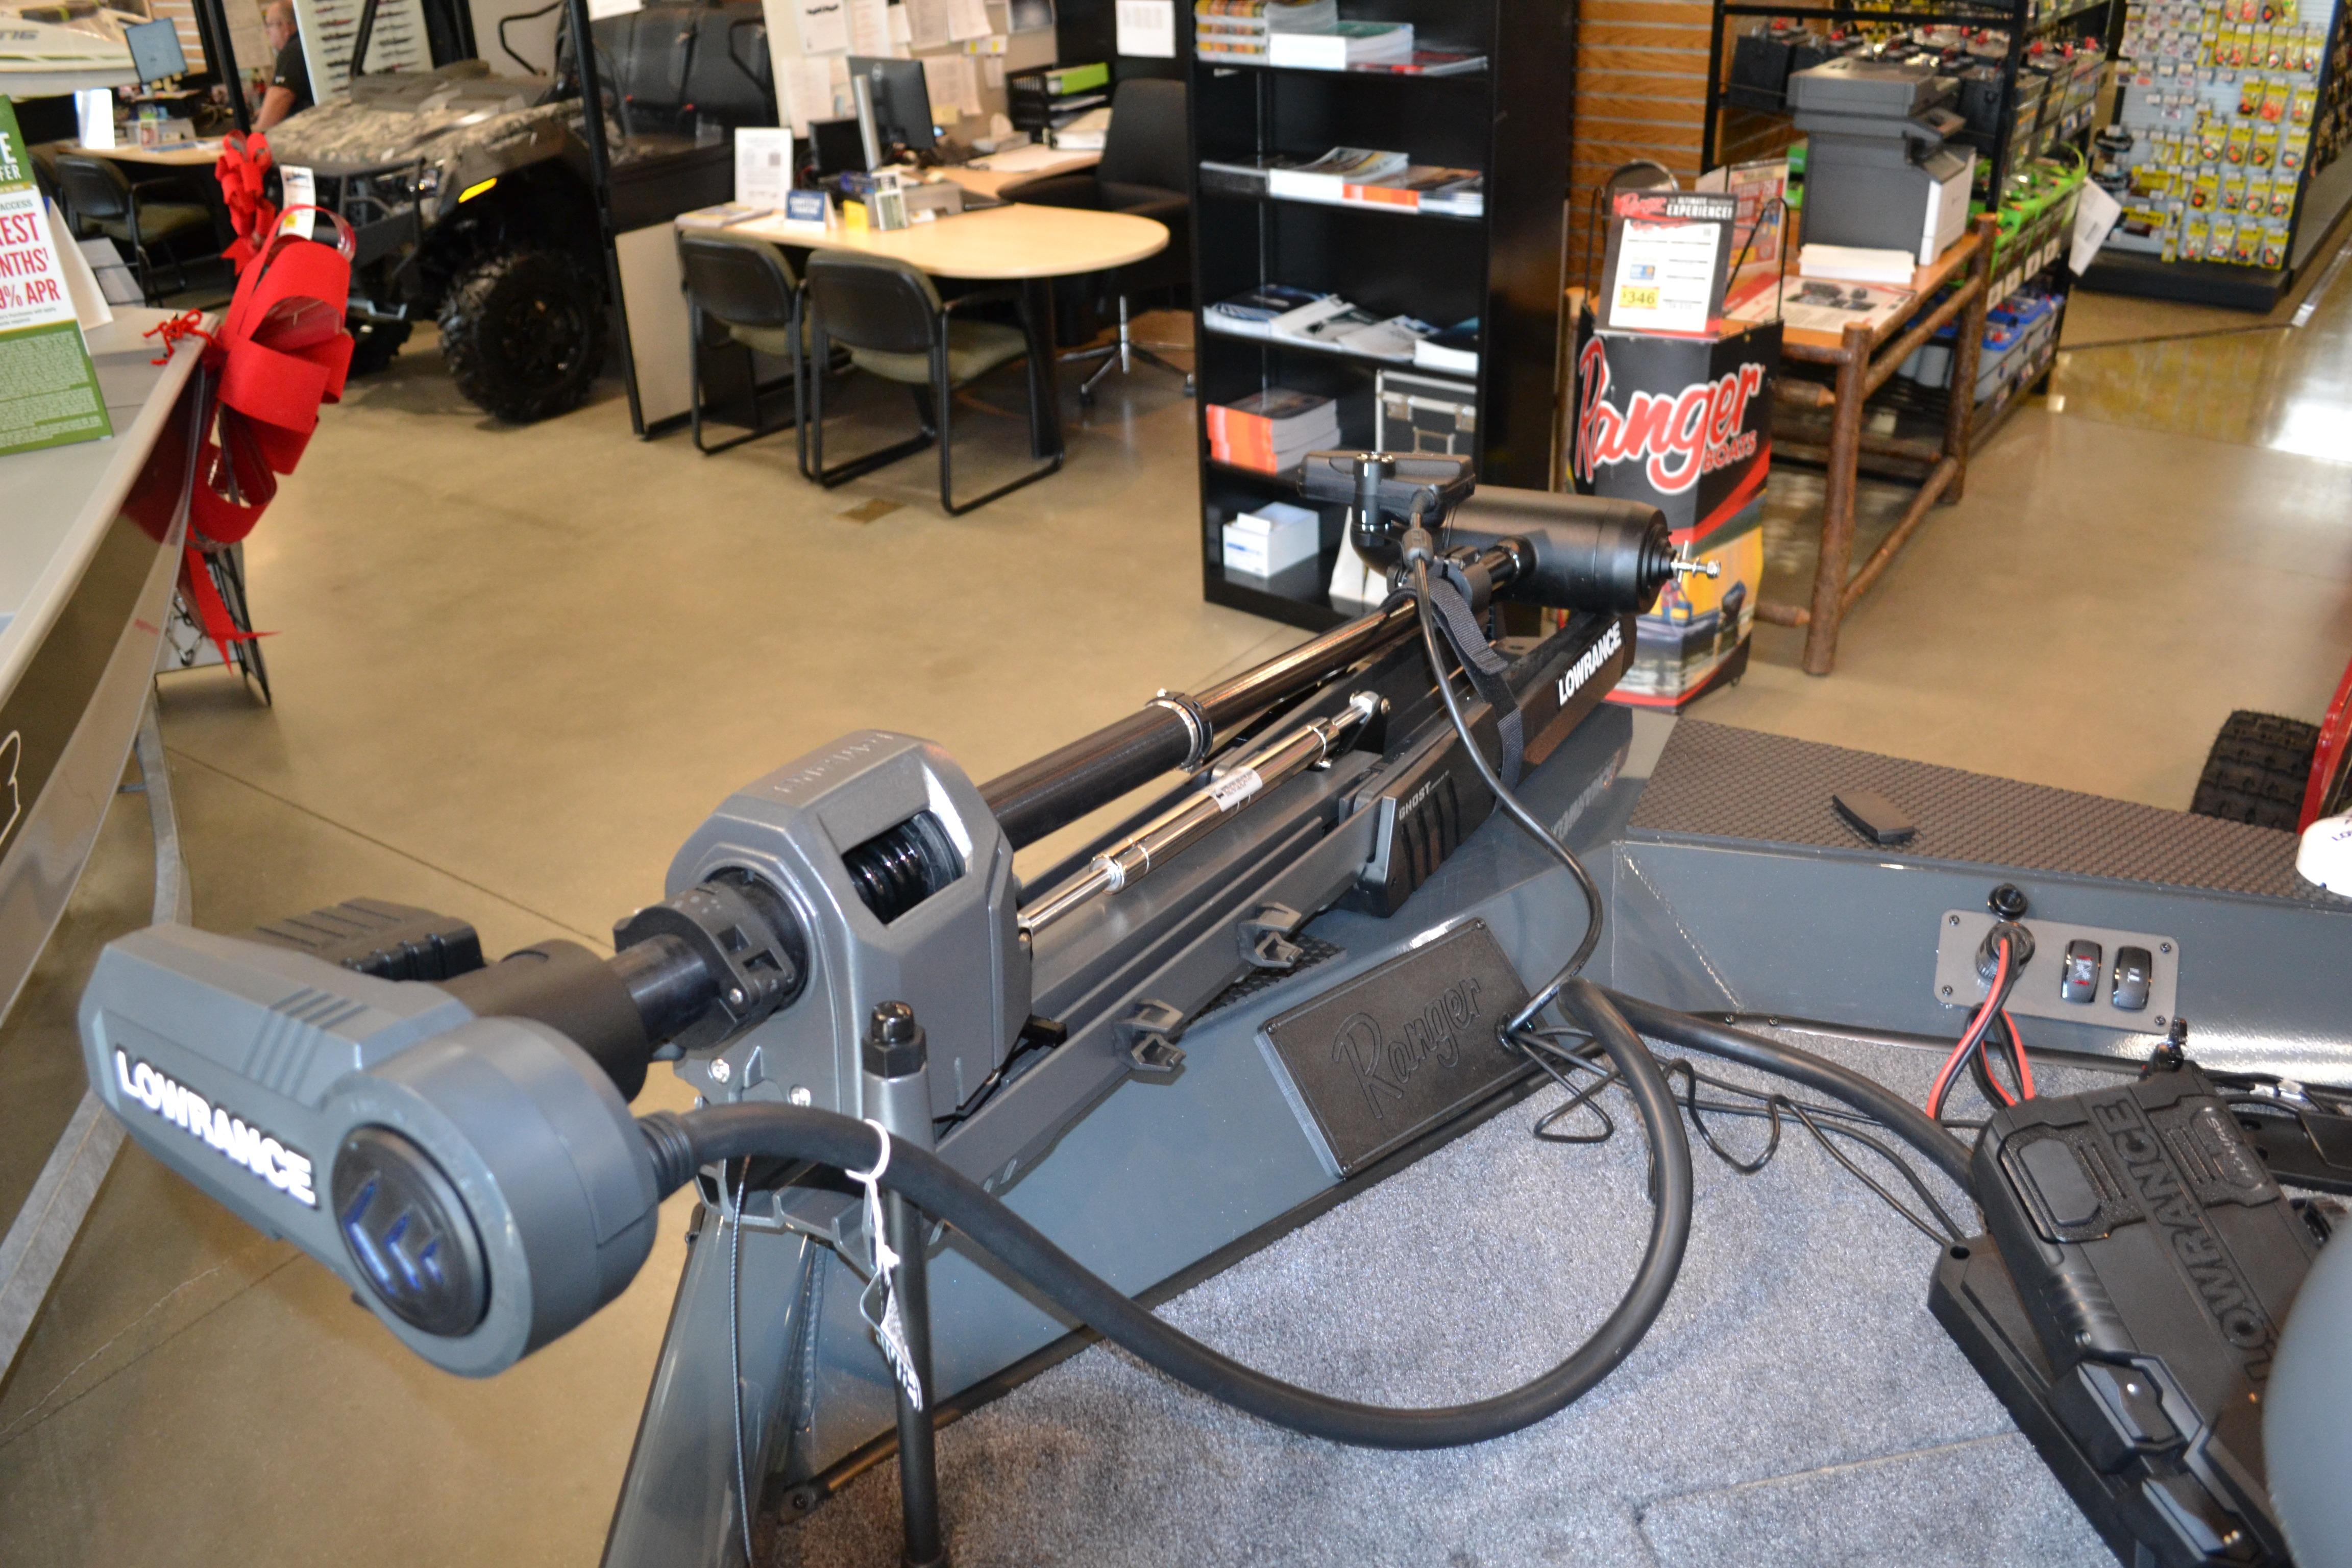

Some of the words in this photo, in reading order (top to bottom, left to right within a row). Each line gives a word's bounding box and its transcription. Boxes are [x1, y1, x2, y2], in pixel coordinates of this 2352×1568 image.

[26, 278, 61, 305] APR
[1575, 336, 1763, 495] Ranger
[1702, 430, 1757, 475] BOATS
[1558, 620, 1622, 706] LOWRANCE
[1399, 780, 1431, 821] GHOST
[1332, 977, 1482, 1119] Ranger
[116, 1049, 316, 1206] LOWRANCE
